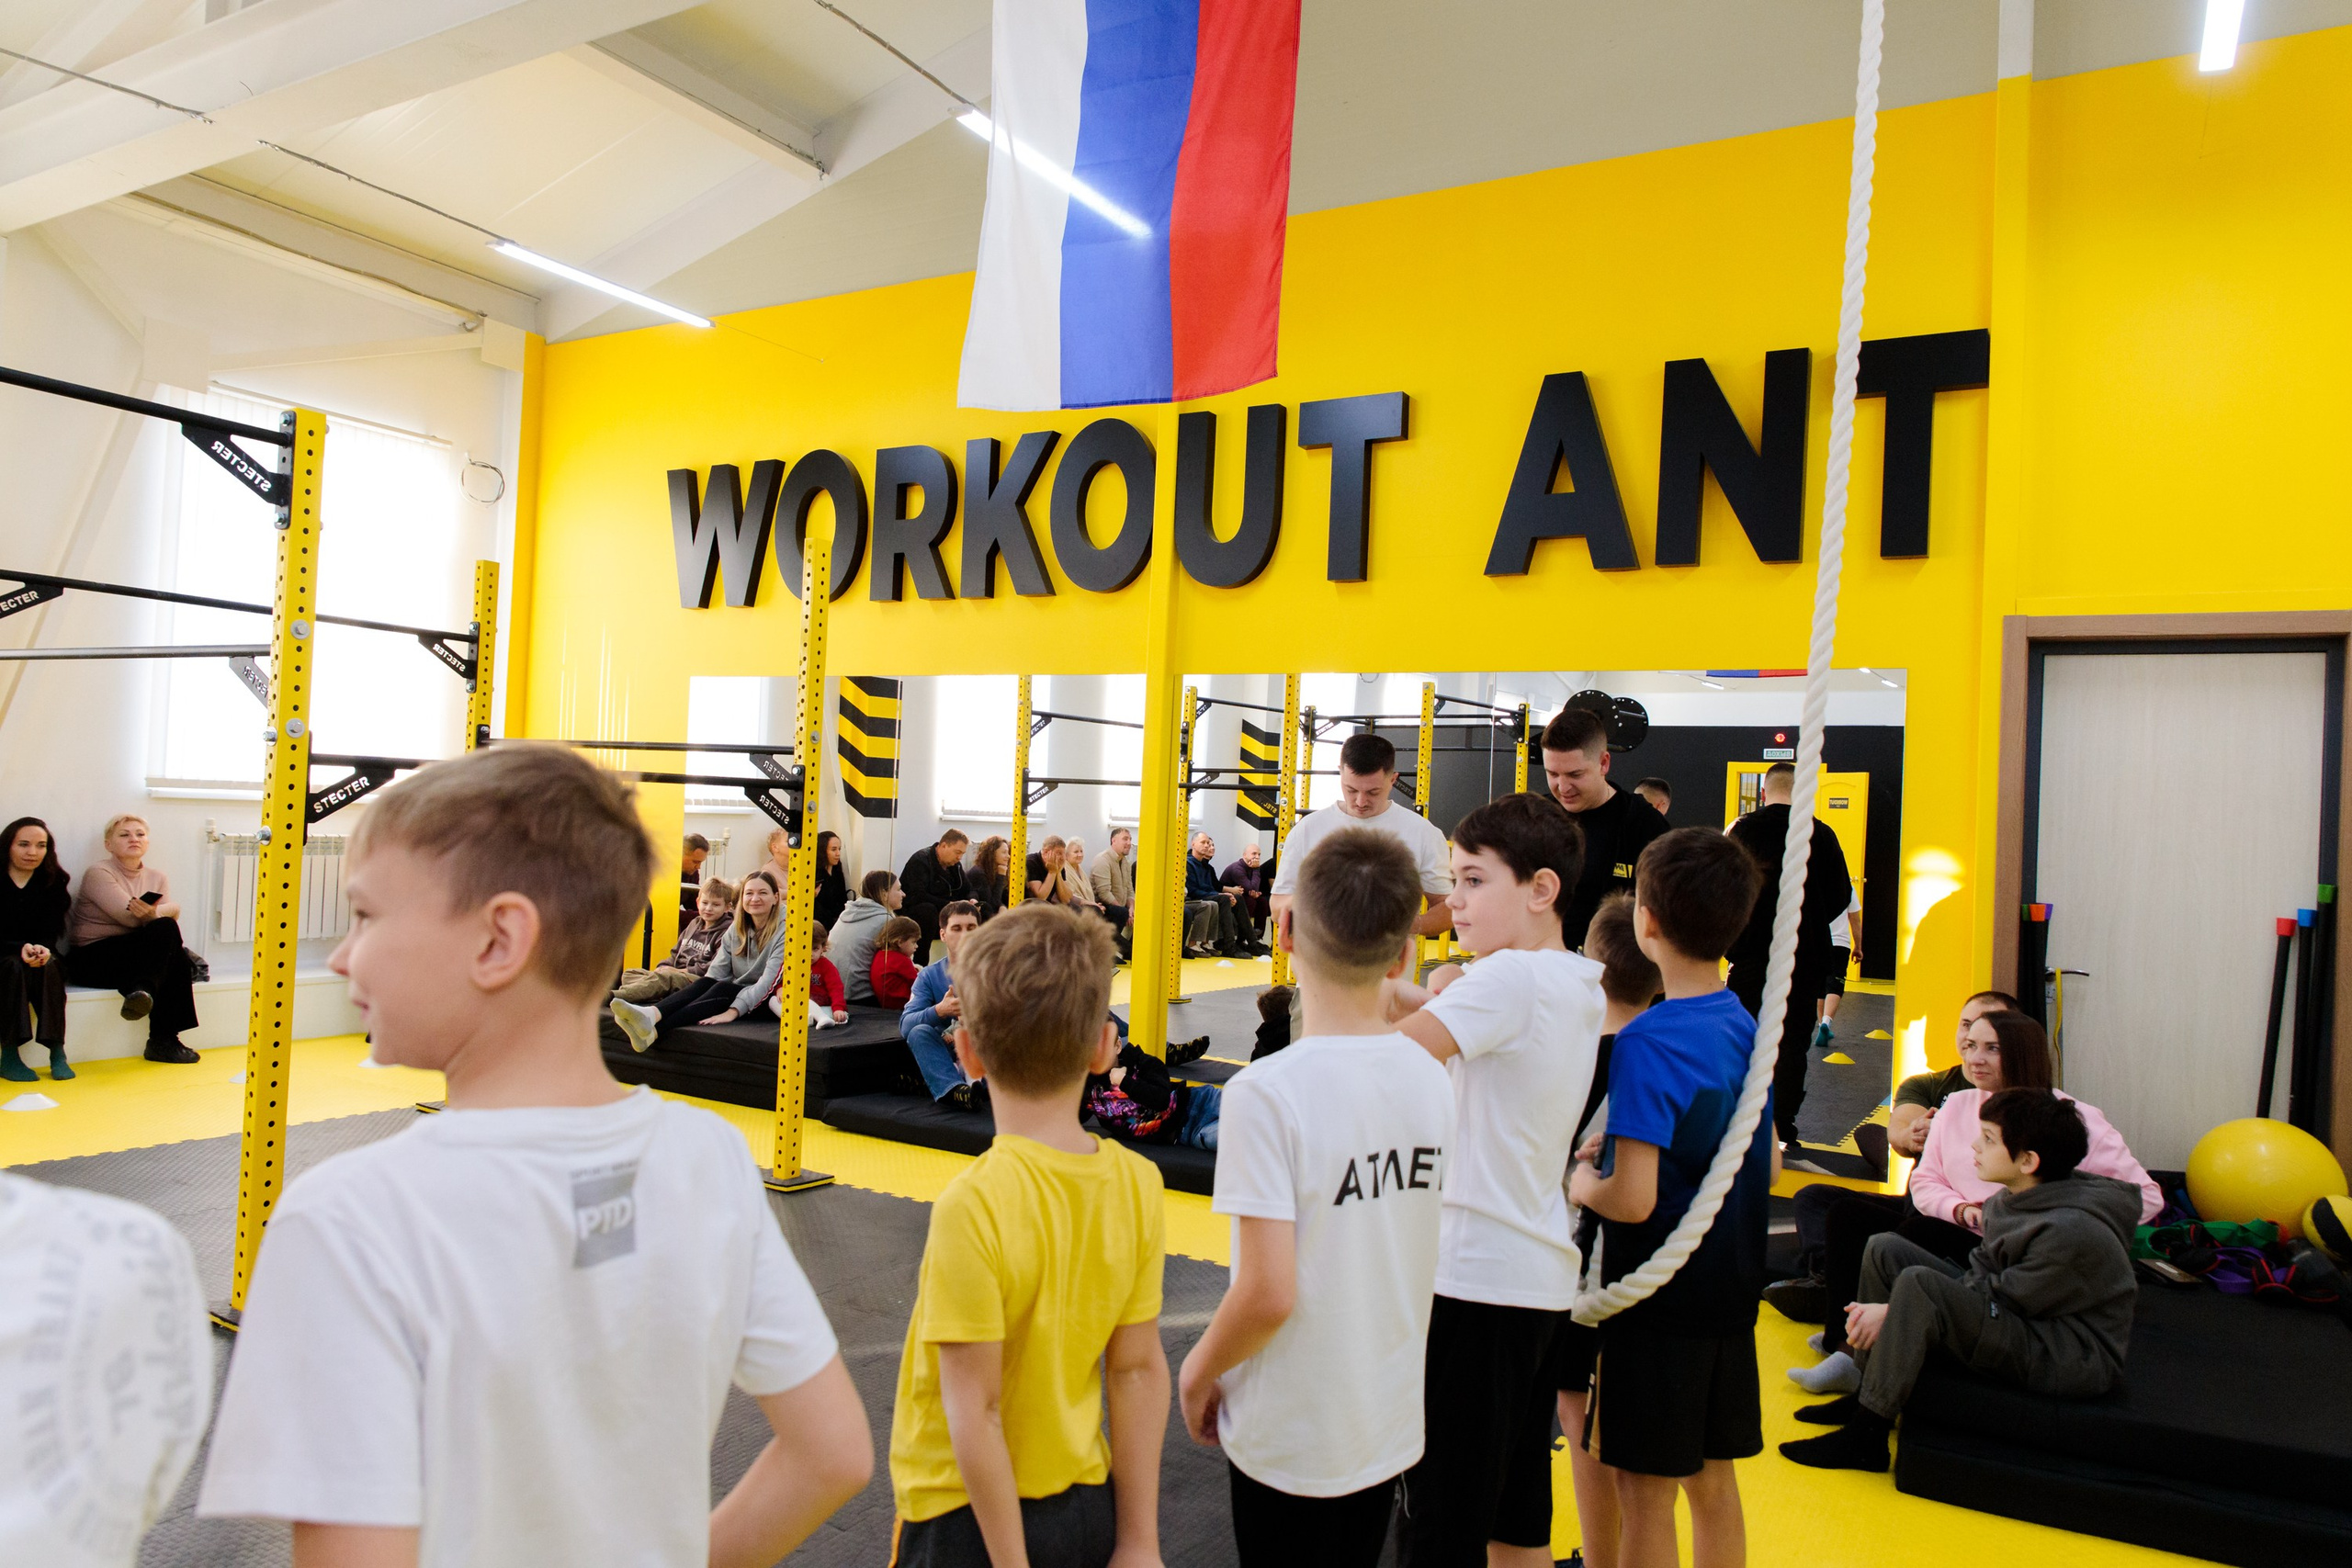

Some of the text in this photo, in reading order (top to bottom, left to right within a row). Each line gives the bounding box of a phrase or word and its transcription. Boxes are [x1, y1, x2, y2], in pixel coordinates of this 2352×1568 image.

[666, 328, 1991, 610] WORKOUT ANT
[0, 591, 40, 614] ECTER
[313, 775, 370, 813] STECTER
